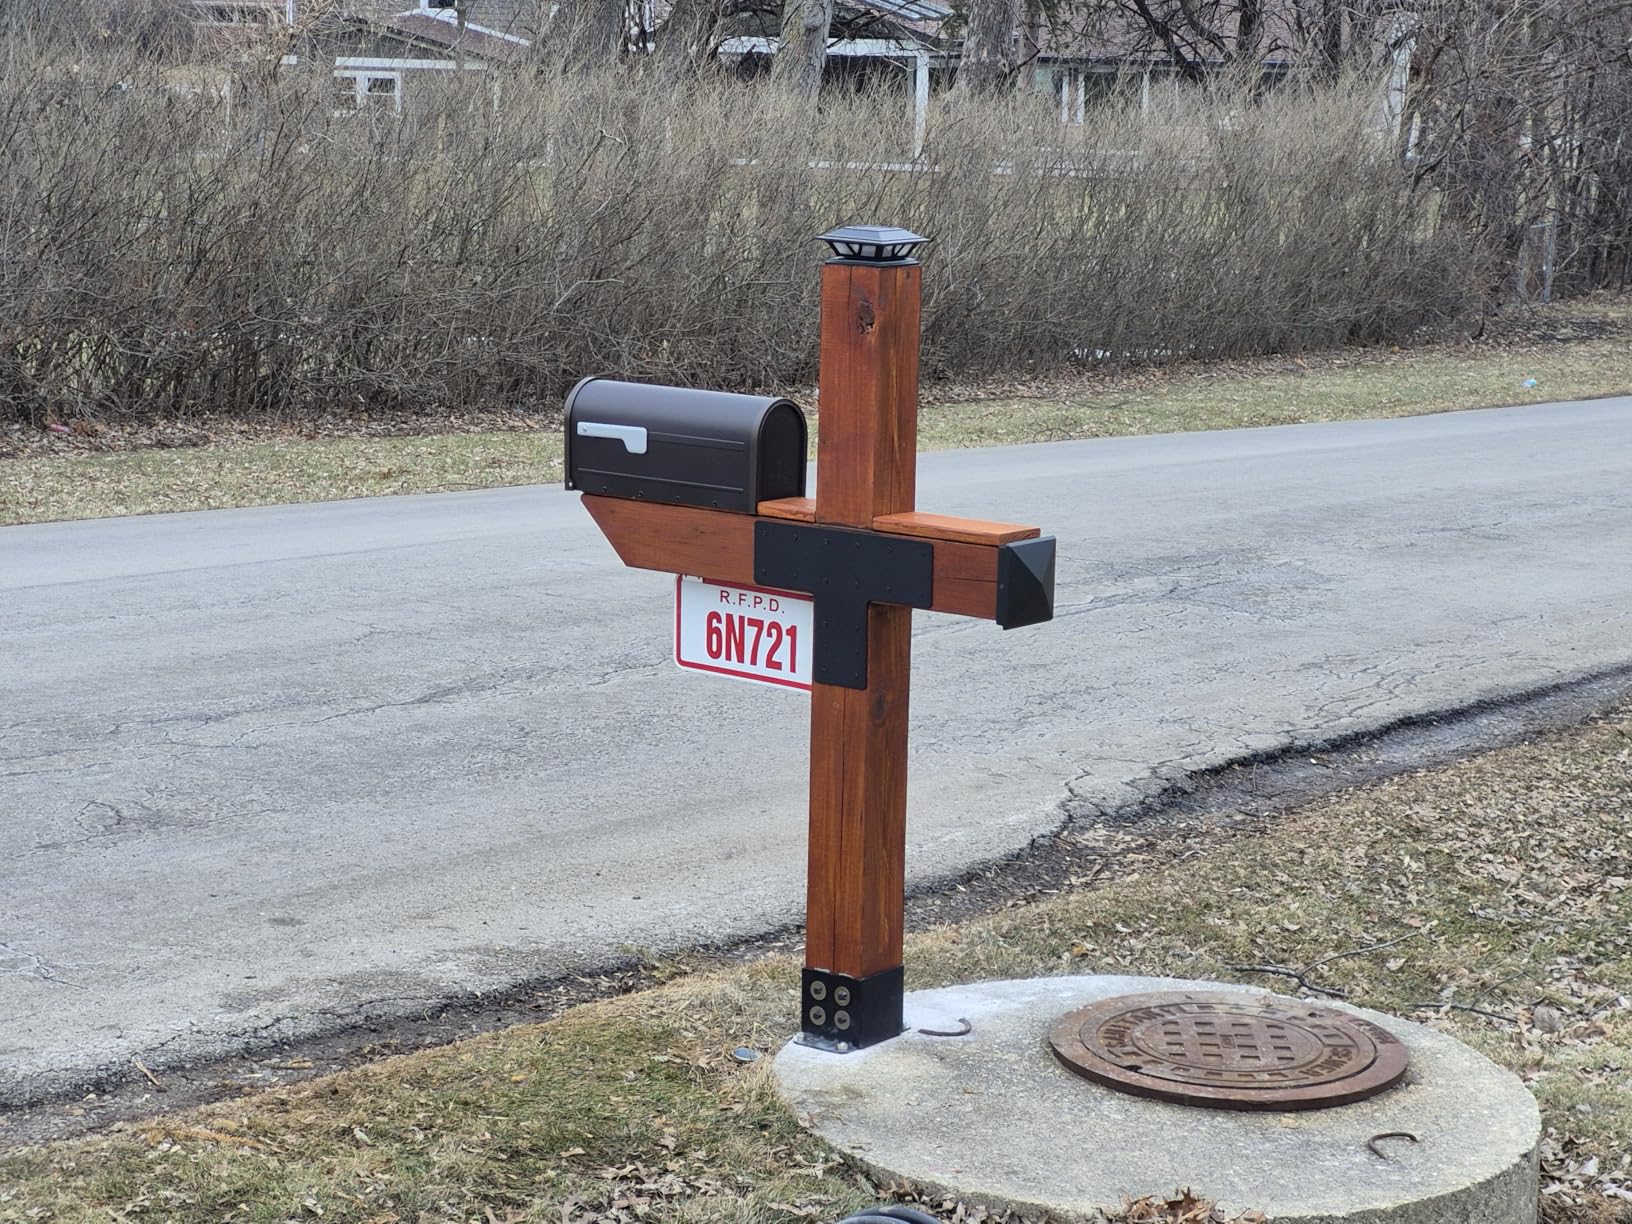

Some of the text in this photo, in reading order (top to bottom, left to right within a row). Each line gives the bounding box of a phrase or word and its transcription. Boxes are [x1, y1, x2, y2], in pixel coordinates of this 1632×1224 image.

[720, 590, 784, 614] R.F.P.D.
[706, 611, 797, 673] 6N721
[1103, 1007, 1178, 1048] SANITARY
[1298, 1047, 1353, 1077] SEWER
